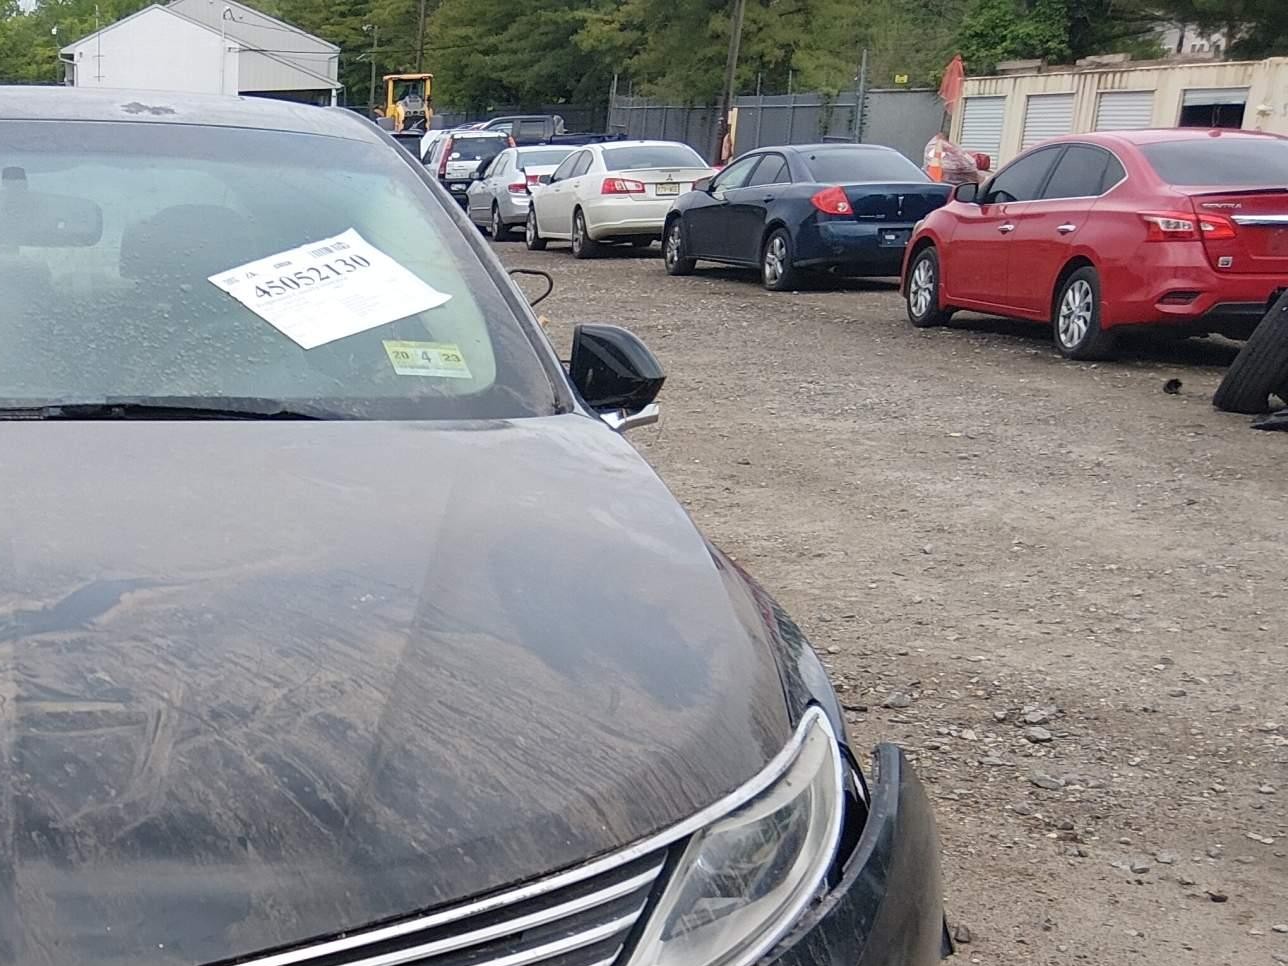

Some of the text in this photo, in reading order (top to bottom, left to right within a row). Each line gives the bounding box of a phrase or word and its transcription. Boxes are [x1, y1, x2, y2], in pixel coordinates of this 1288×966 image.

[255, 254, 371, 298] 45052130
[392, 350, 410, 360] 20
[421, 351, 432, 363] 4
